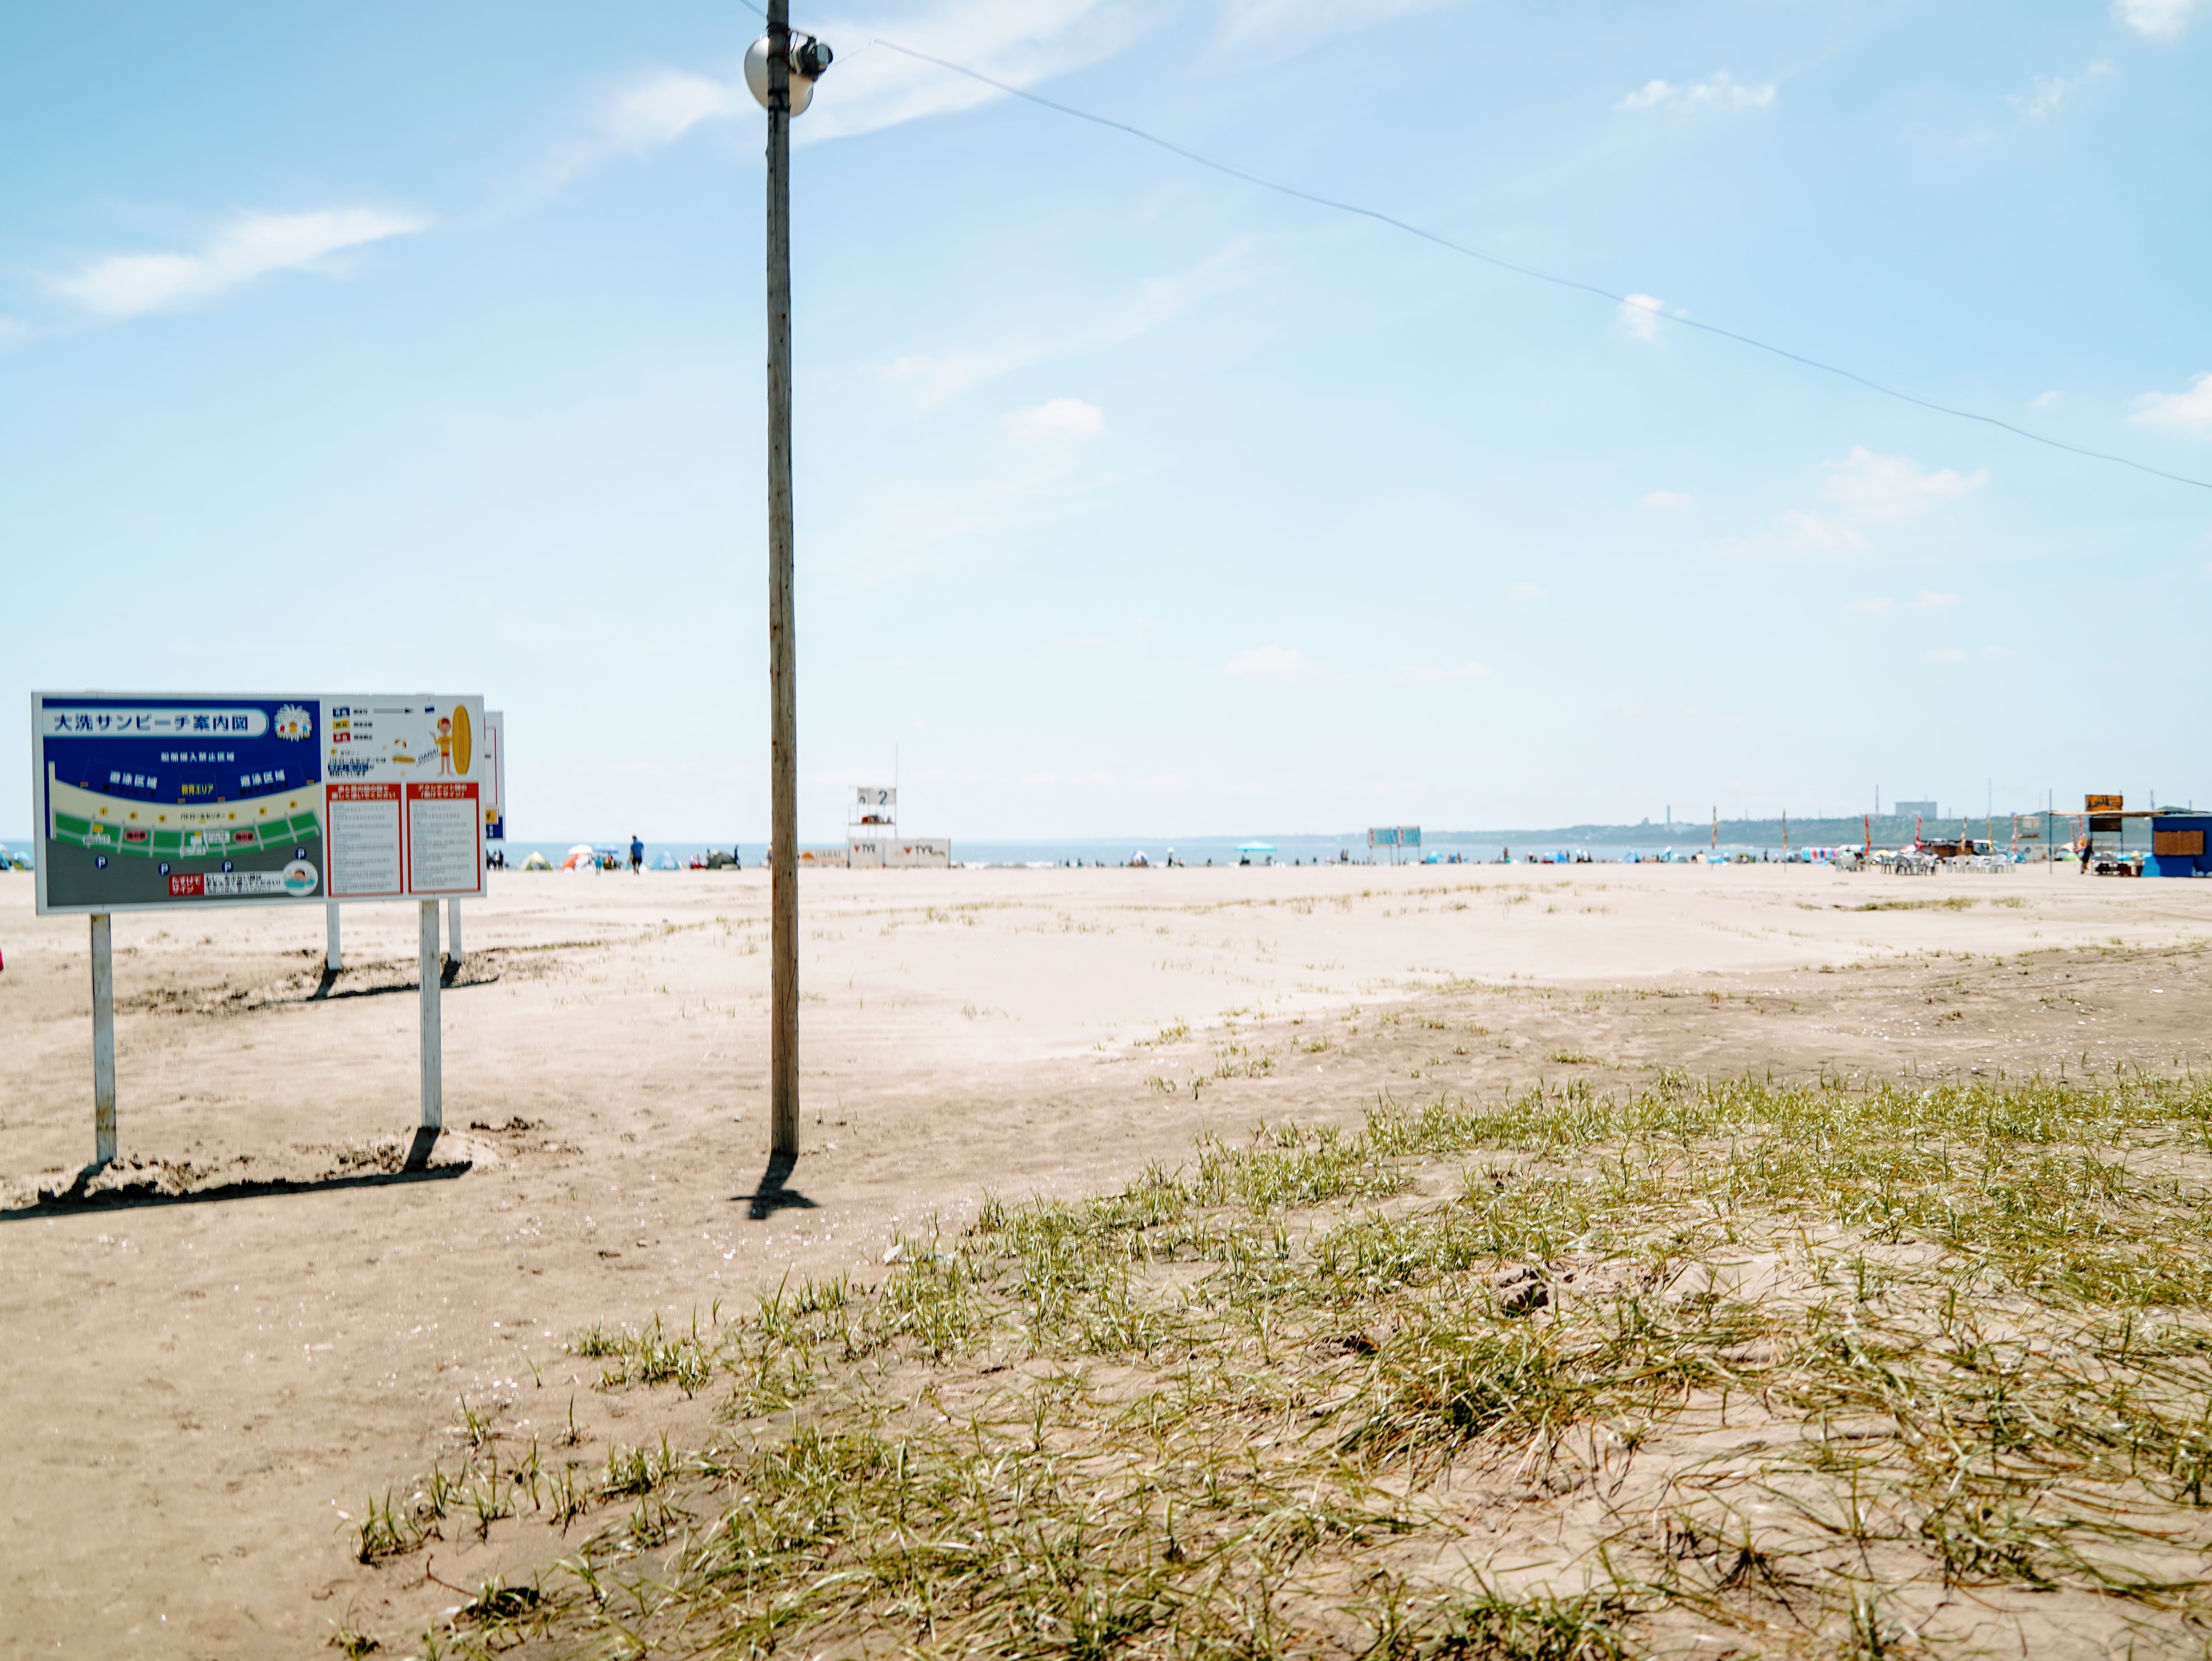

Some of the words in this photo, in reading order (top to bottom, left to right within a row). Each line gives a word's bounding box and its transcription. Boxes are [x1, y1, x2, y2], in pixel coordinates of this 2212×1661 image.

[54, 713, 248, 732] 大洗サンビーチ案内図
[161, 751, 235, 762] 船舶侵入禁止区域
[110, 771, 157, 790] 遊泳区域
[240, 769, 285, 788] 遊泳区域
[878, 790, 887, 804] 2
[298, 848, 305, 860] P
[862, 843, 876, 854] TYR
[915, 845, 933, 855] TYR
[98, 856, 105, 869] P
[225, 861, 232, 872] P
[161, 863, 168, 875] P
[172, 875, 202, 885] たすけて
[172, 884, 194, 894] サイン
